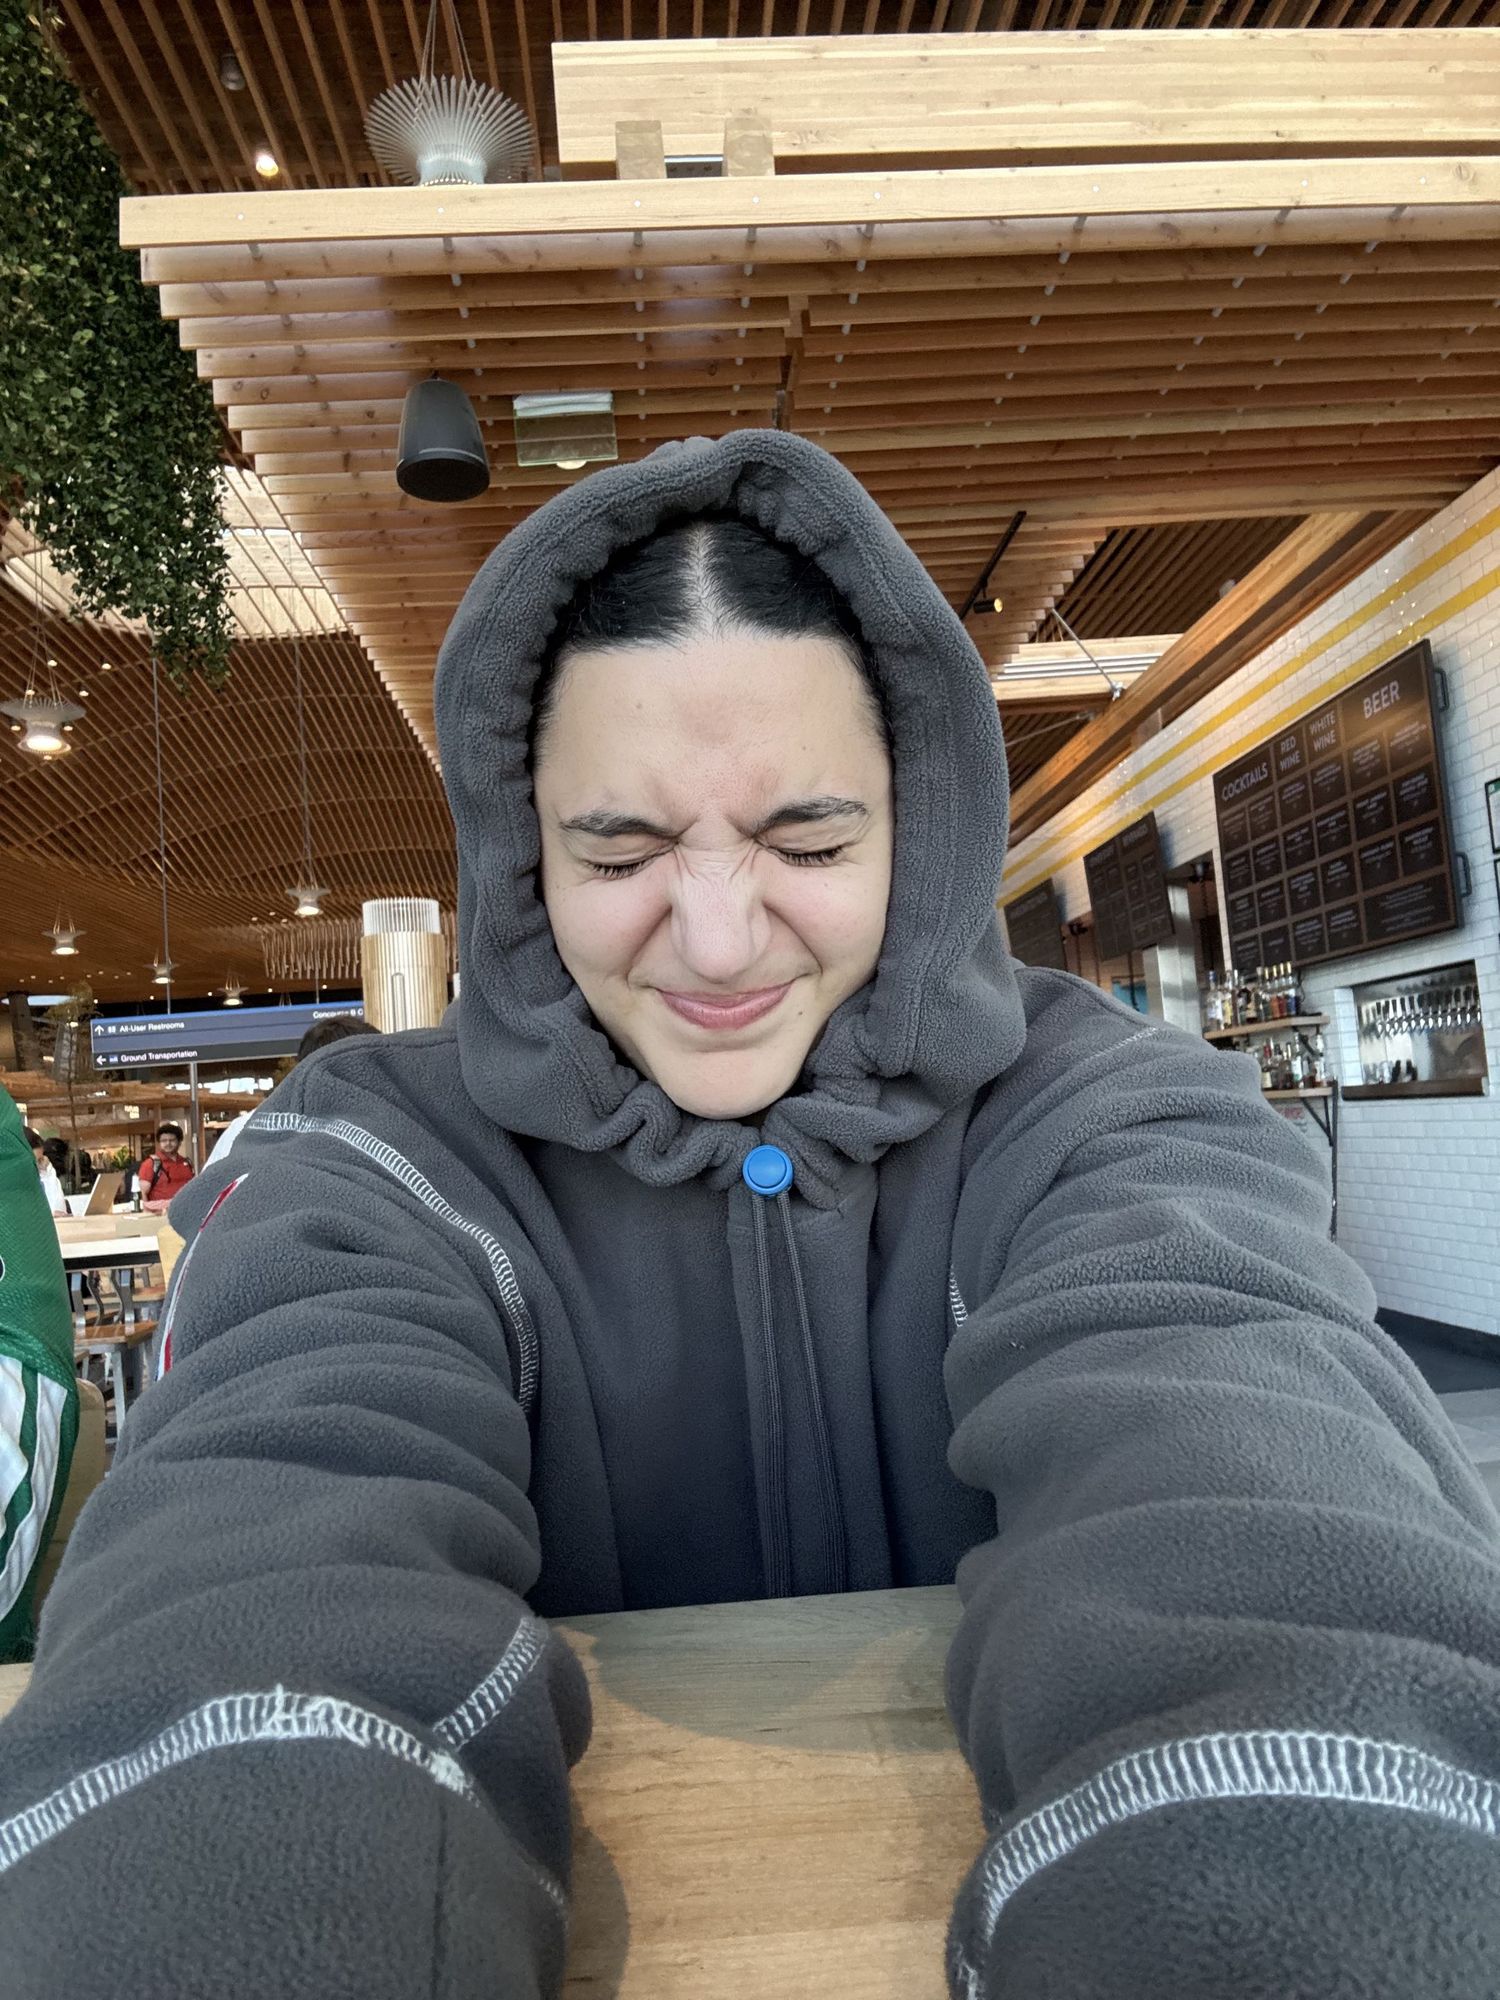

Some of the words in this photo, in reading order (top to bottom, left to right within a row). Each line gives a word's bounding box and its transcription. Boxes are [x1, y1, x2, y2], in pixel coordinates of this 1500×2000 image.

[1363, 680, 1400, 719] BEER
[1310, 711, 1336, 735] WHITE
[1281, 736, 1297, 753] RED
[1313, 730, 1336, 752] WINE
[1280, 750, 1300, 771] WINE
[1222, 762, 1268, 801] COCKTAILS
[119, 1025, 147, 1033] All-User
[148, 1022, 184, 1031] Restrooms
[120, 1053, 147, 1063] Ground
[148, 1050, 198, 1061] Transportation
